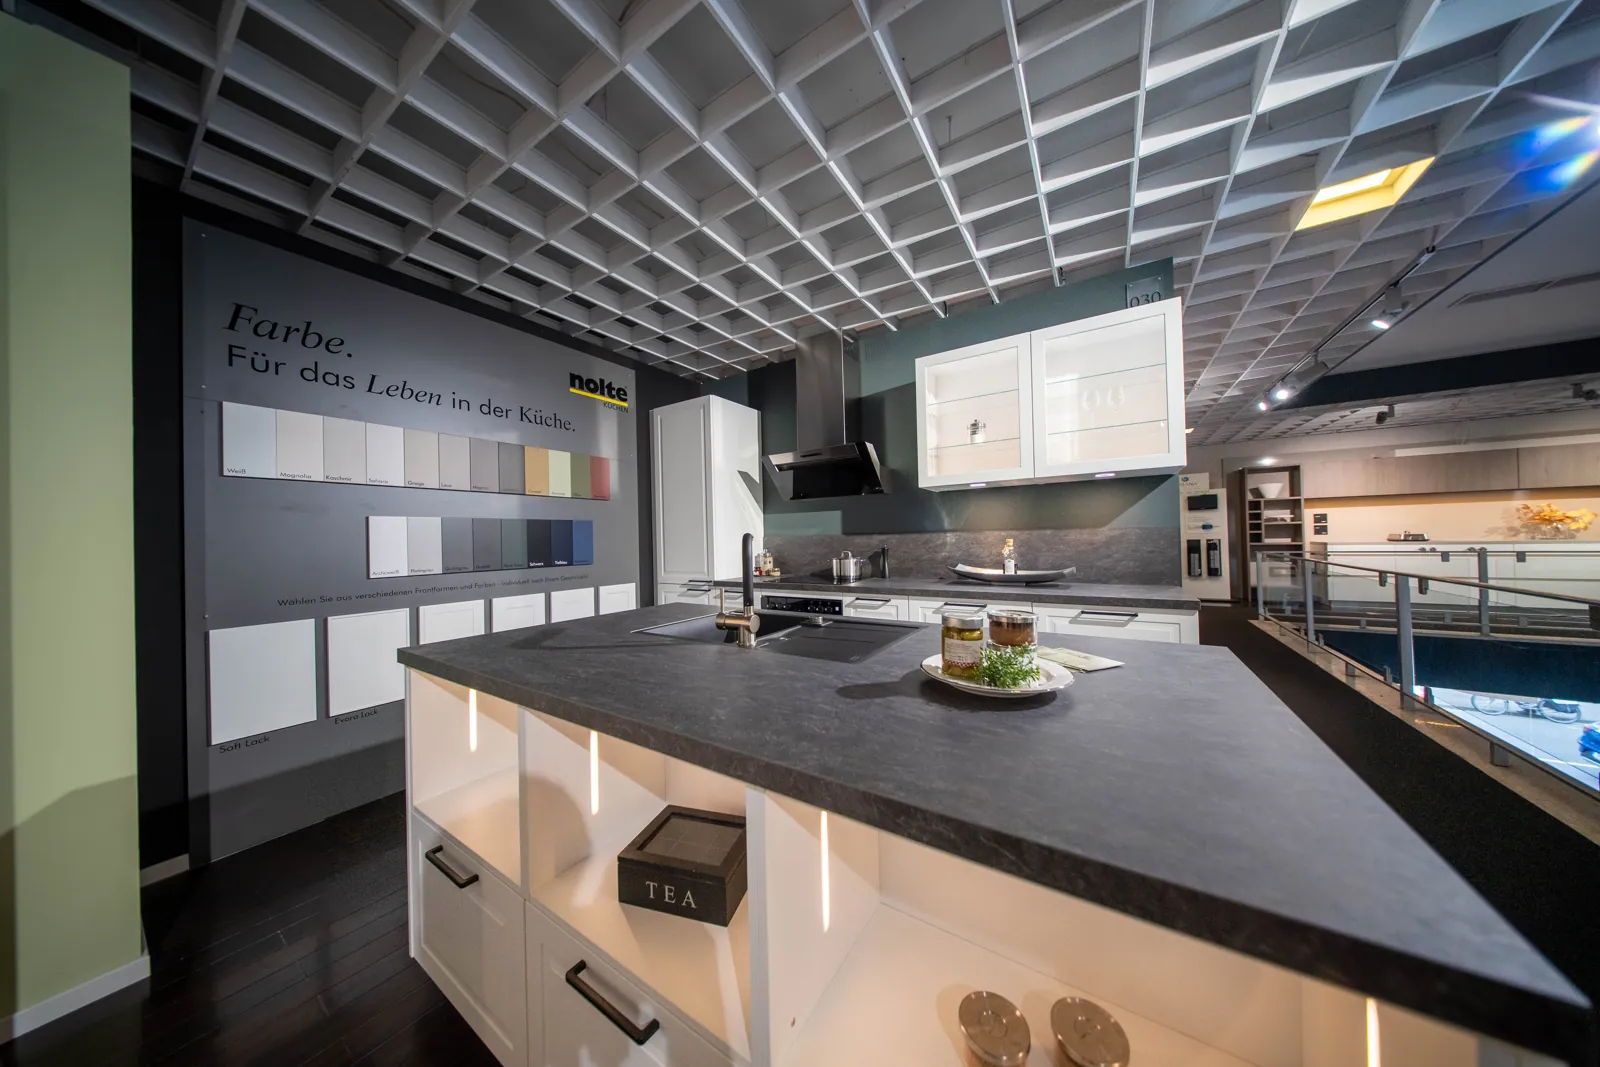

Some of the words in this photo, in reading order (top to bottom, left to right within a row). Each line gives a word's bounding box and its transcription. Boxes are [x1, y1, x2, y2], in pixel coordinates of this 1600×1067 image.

[222, 302, 353, 358] Farbe.
[228, 344, 286, 376] Für
[300, 361, 356, 390] das
[366, 373, 442, 406] Leben
[452, 391, 470, 412] in
[479, 398, 512, 419] der
[519, 405, 576, 432] Küche.
[569, 372, 628, 402] nolte
[227, 467, 246, 475] Weiß
[279, 472, 312, 480] Magnolia
[319, 594, 333, 603] Sie
[355, 589, 413, 600] verschiedenen
[415, 584, 458, 594] Frontformen
[460, 582, 473, 590] und
[474, 580, 496, 589] Farben
[361, 708, 378, 718] Lack
[219, 743, 241, 754] Soft
[245, 735, 270, 747] Lack
[645, 881, 697, 909] TEA
